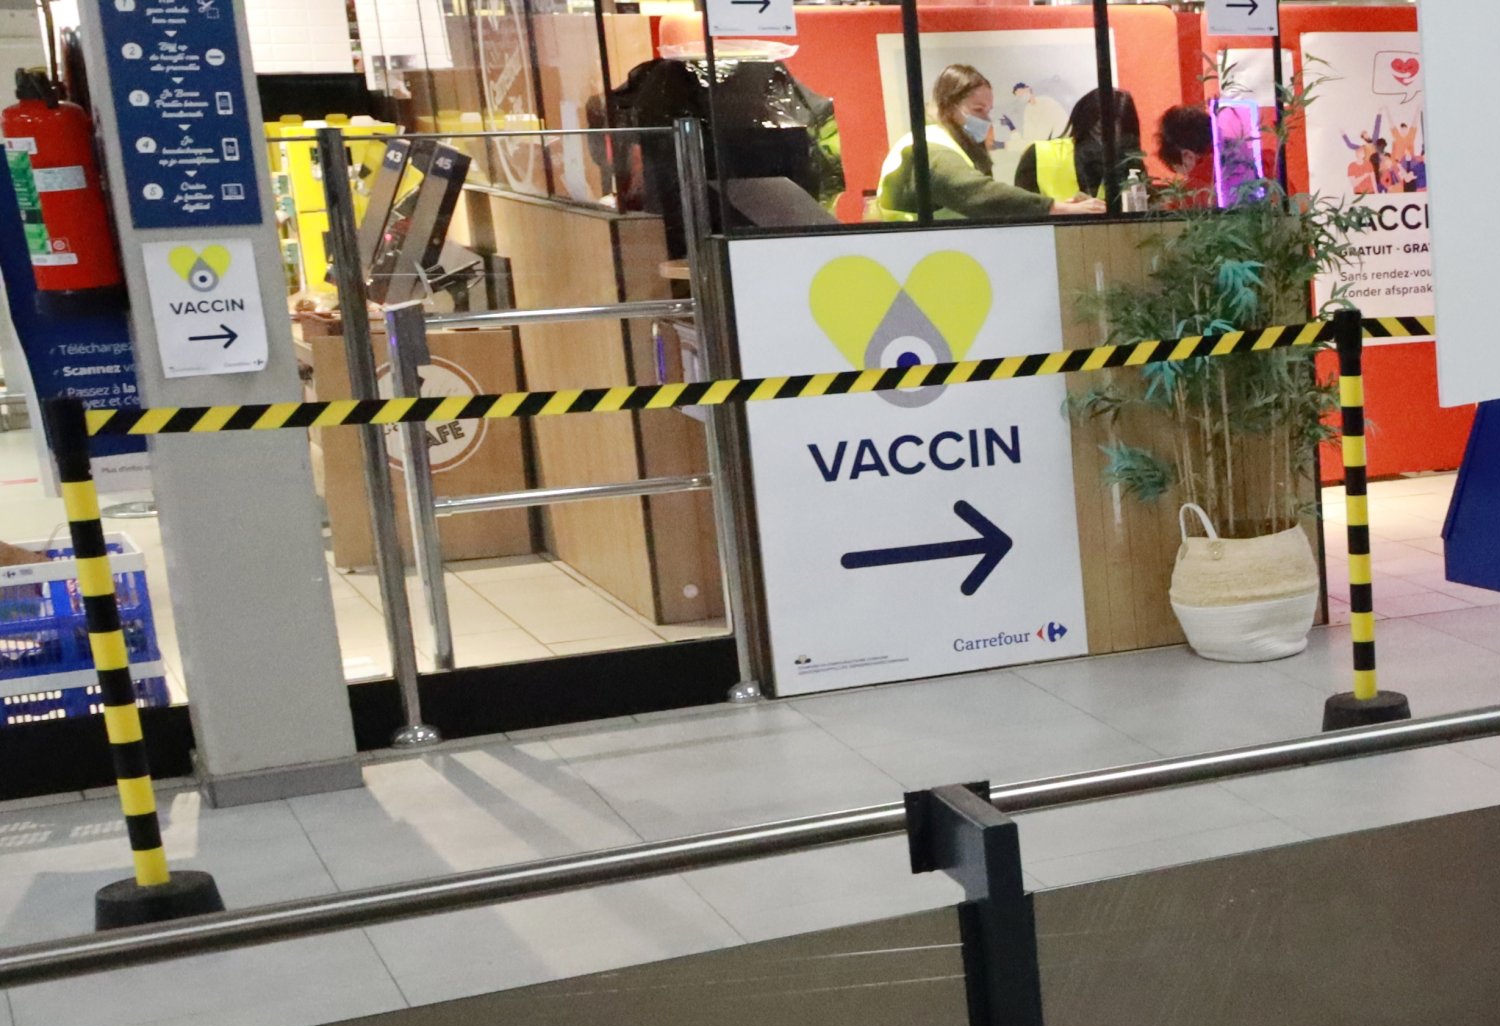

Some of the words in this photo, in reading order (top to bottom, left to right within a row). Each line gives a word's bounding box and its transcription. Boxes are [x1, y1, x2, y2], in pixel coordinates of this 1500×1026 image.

[386, 149, 402, 163] 43
[435, 156, 452, 170] 45
[1403, 243, 1431, 253] GRA
[1340, 271, 1368, 281] Sans
[1384, 283, 1433, 297] afspraak
[169, 298, 245, 315] VACCIN
[62, 364, 122, 377] Scannez
[67, 386, 110, 398] Passez
[424, 420, 466, 448] AFE
[807, 425, 1022, 483] VACCIN
[953, 631, 1031, 652] Carrefour
